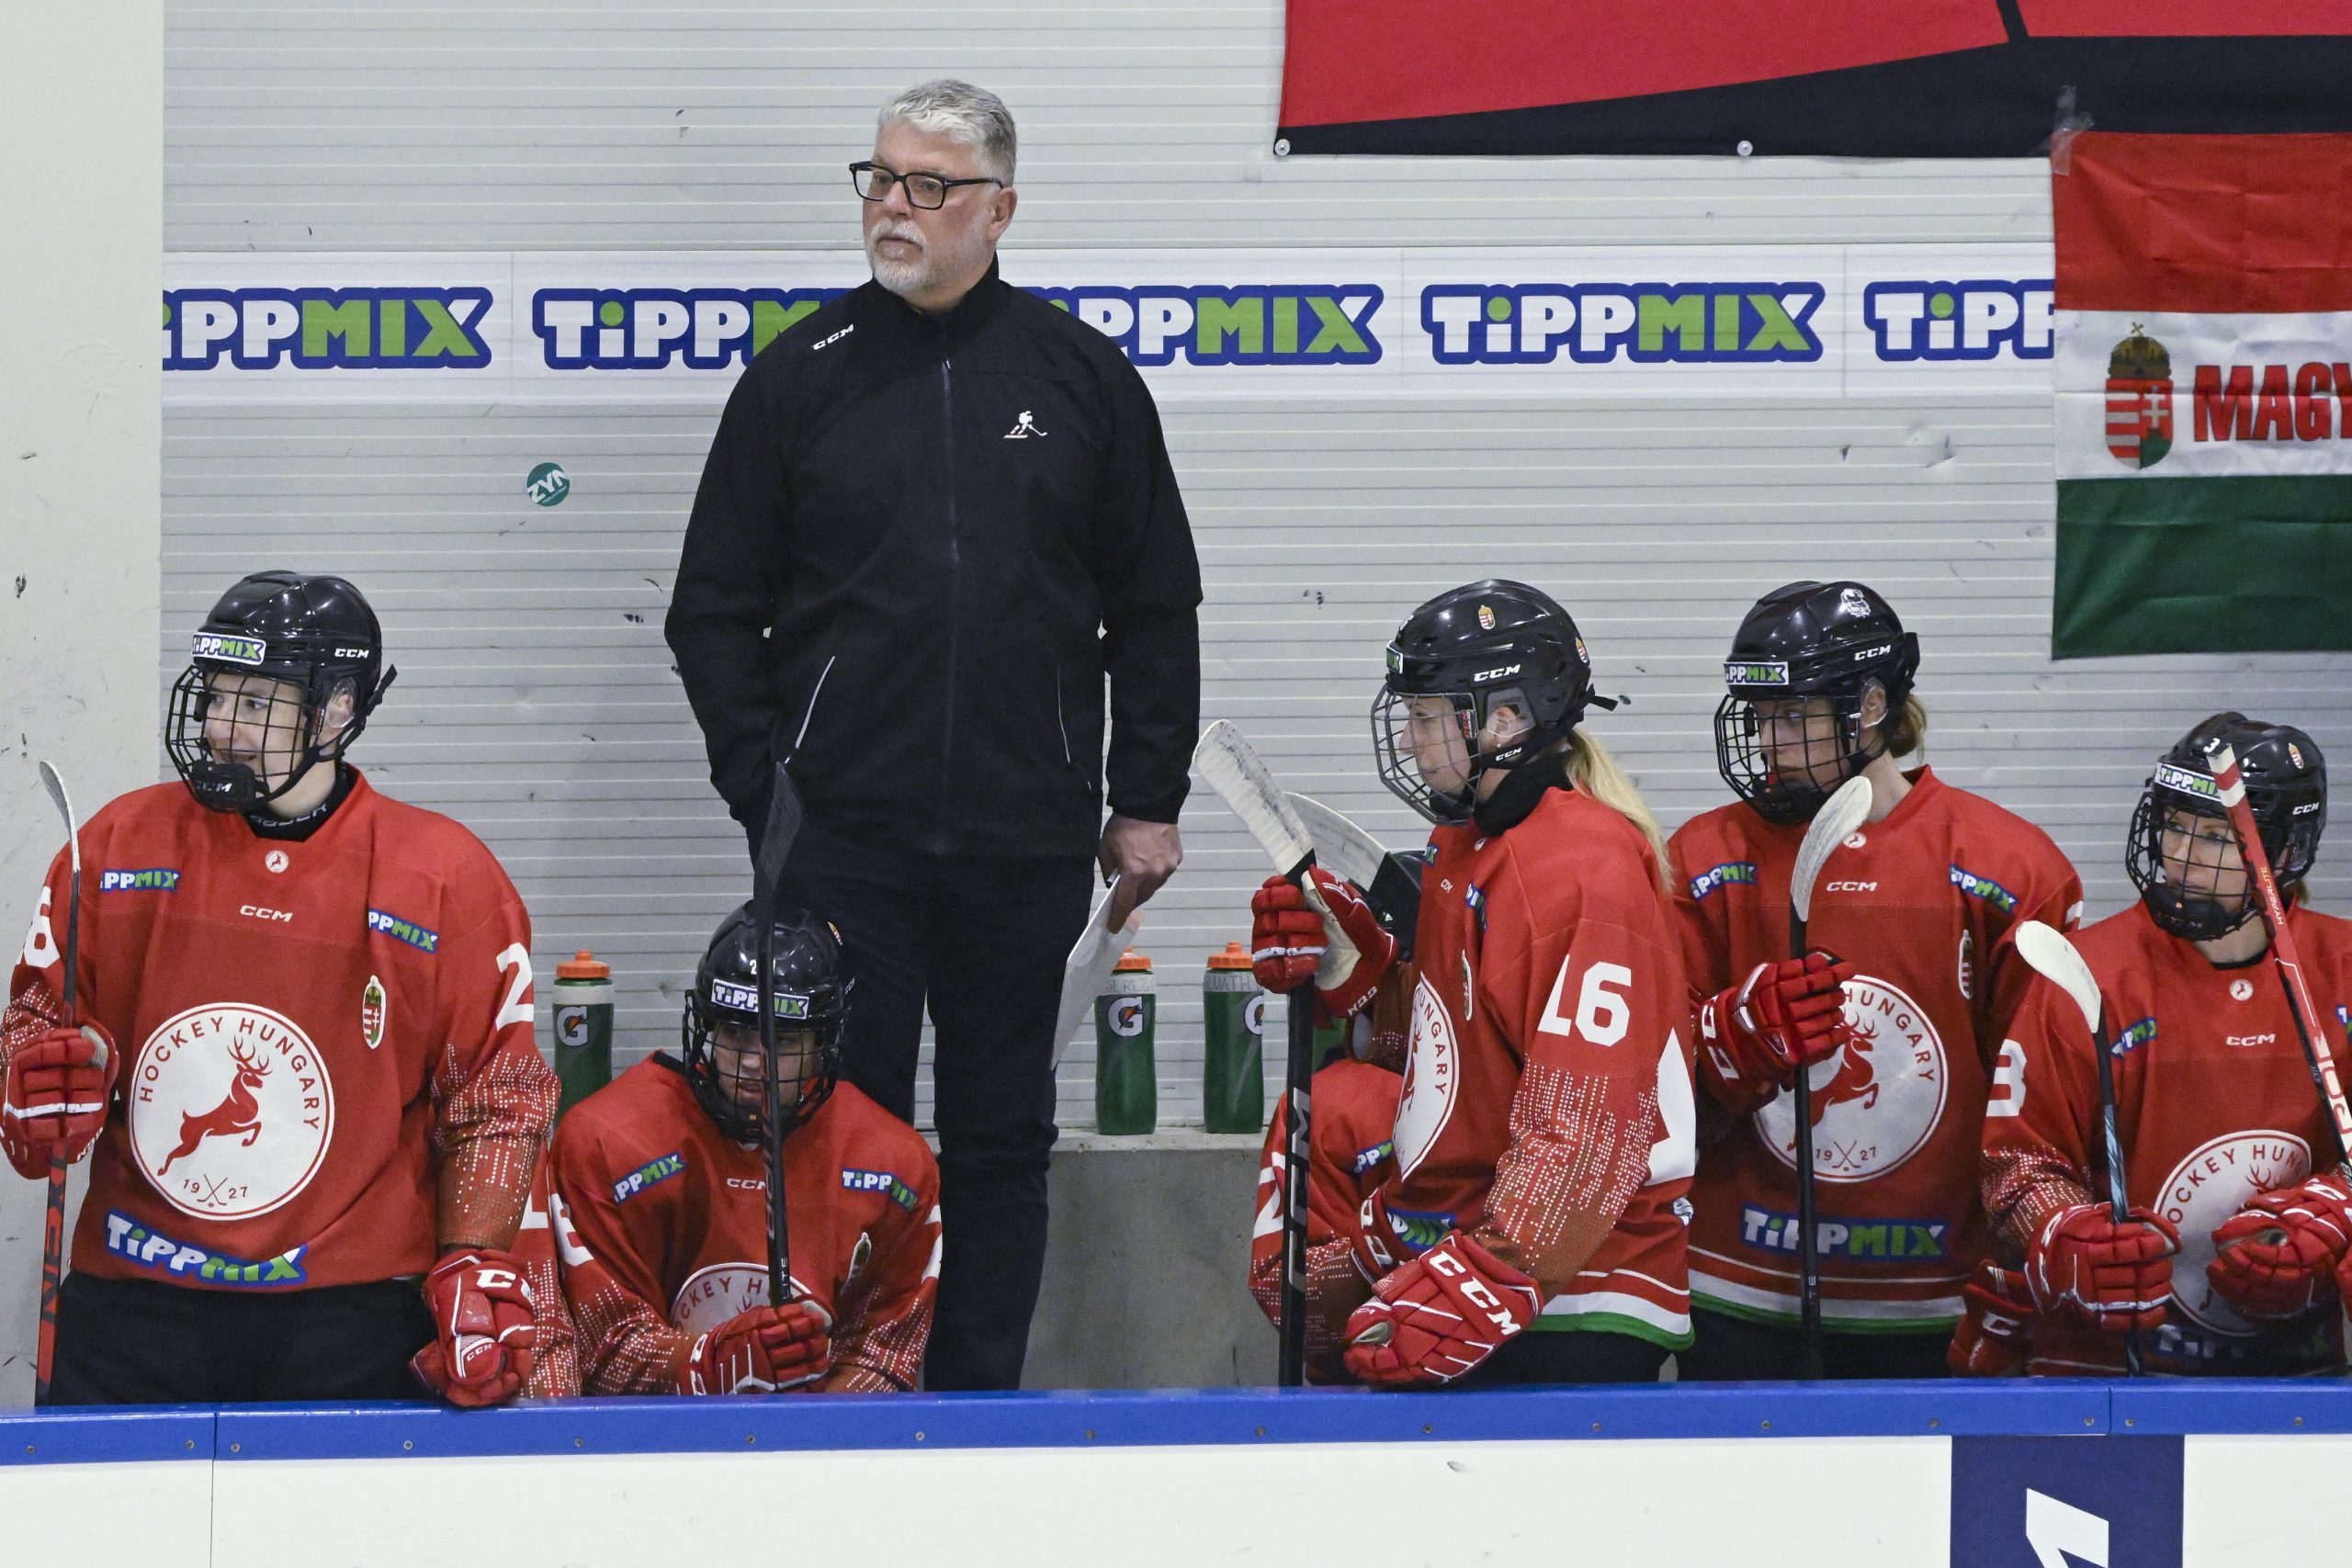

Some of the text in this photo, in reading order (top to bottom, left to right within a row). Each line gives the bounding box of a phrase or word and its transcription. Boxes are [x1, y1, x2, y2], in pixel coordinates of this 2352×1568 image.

[1430, 291, 1815, 355] TiPPMIX
[1873, 288, 2055, 351] TiPP
[810, 322, 855, 351] CCM
[334, 648, 370, 659] CCM
[1853, 644, 1892, 661] CCM
[1473, 663, 1521, 682] CCM
[1495, 747, 1522, 761] CCM
[2160, 767, 2220, 795] TiPPMI
[2291, 801, 2320, 816] CCM
[99, 871, 180, 890] PPMIX
[1826, 881, 1878, 893] CCM
[2260, 866, 2285, 925] HYPERLITE
[239, 904, 294, 922] CCM
[714, 985, 806, 1015] TiPPIX
[1416, 988, 1448, 1097] UNGARY
[2225, 1032, 2277, 1047] CCM
[139, 1016, 321, 1131] HOCKEY HUNGARY
[1815, 1146, 1878, 1161] 19 27
[183, 1178, 248, 1200] 19 27
[614, 1154, 685, 1203] PPMIX
[2165, 1145, 2238, 1225] OCKEY
[106, 1212, 303, 1282] TiPPMIX
[1428, 1249, 1523, 1337] CCM
[466, 1344, 492, 1362] CCM
